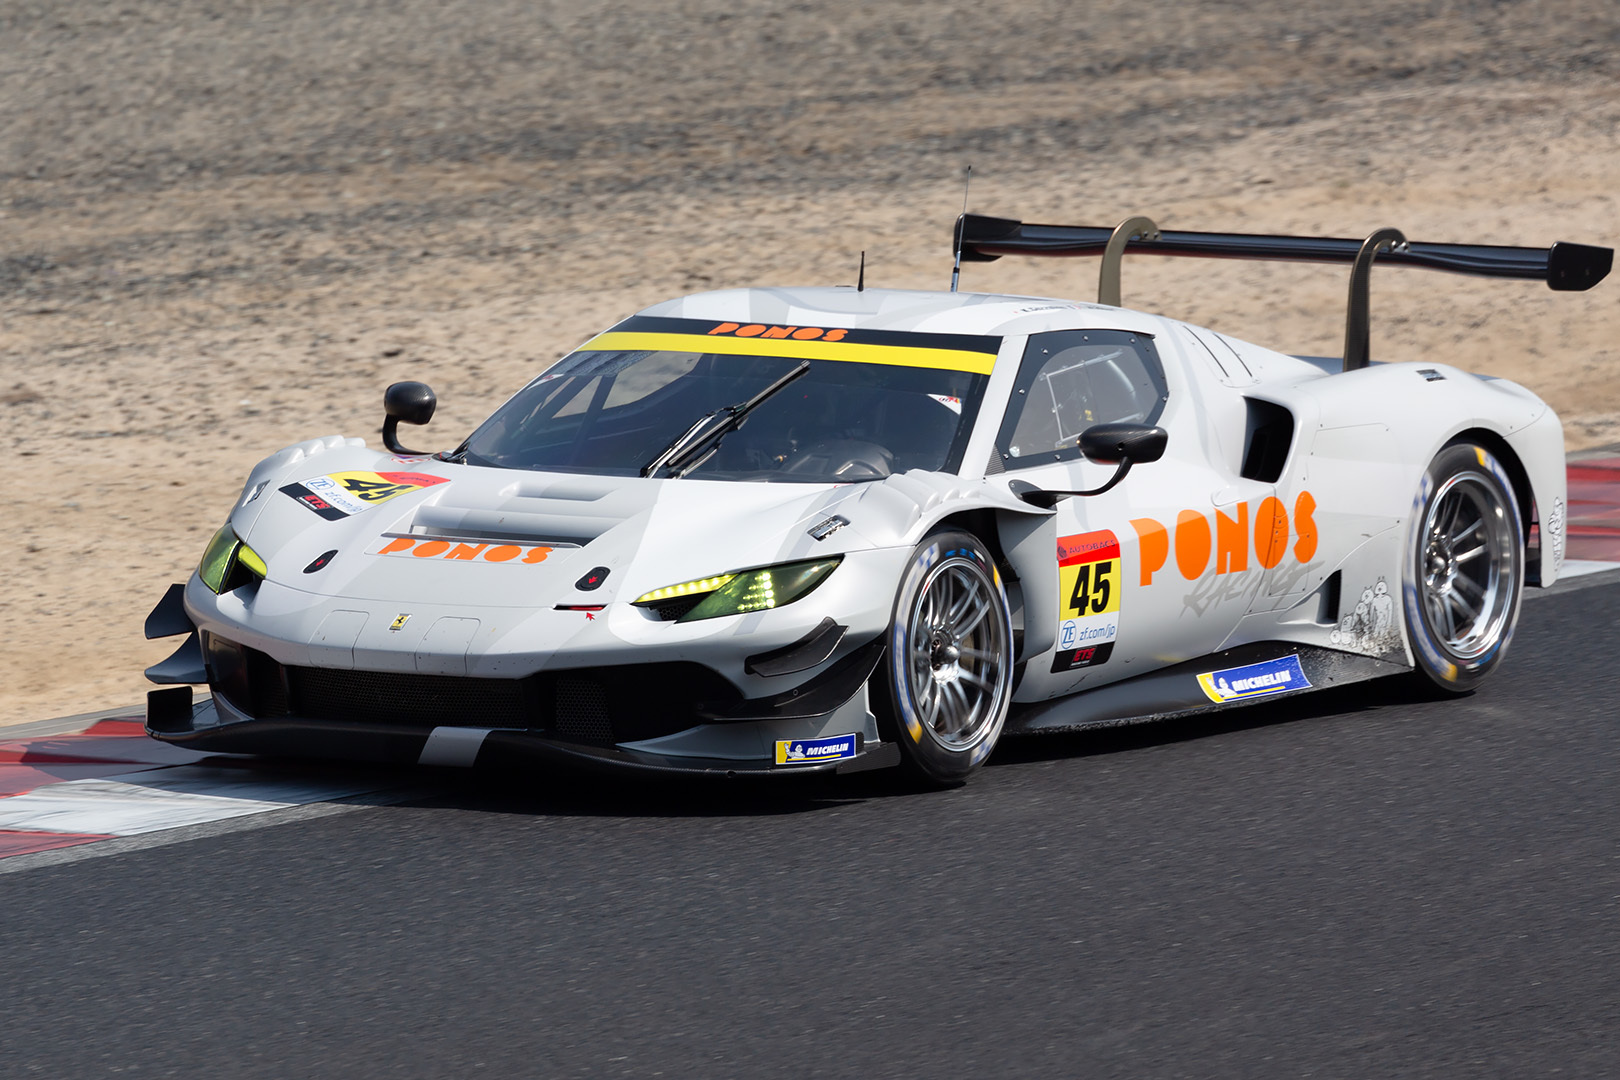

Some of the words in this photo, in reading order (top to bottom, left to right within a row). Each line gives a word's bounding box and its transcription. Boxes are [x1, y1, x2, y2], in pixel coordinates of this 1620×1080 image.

[707, 322, 848, 341] PONOS
[344, 478, 414, 501] 45
[1069, 539, 1117, 554] AUTOBACS
[1128, 490, 1318, 587] PONOS
[377, 538, 553, 564] PONOS
[1069, 561, 1112, 617] 45
[1079, 623, 1116, 641] zf.com/jp
[1073, 647, 1096, 662] ETS
[1231, 669, 1292, 692] MICHELIN
[806, 743, 849, 756] MICHELIN
